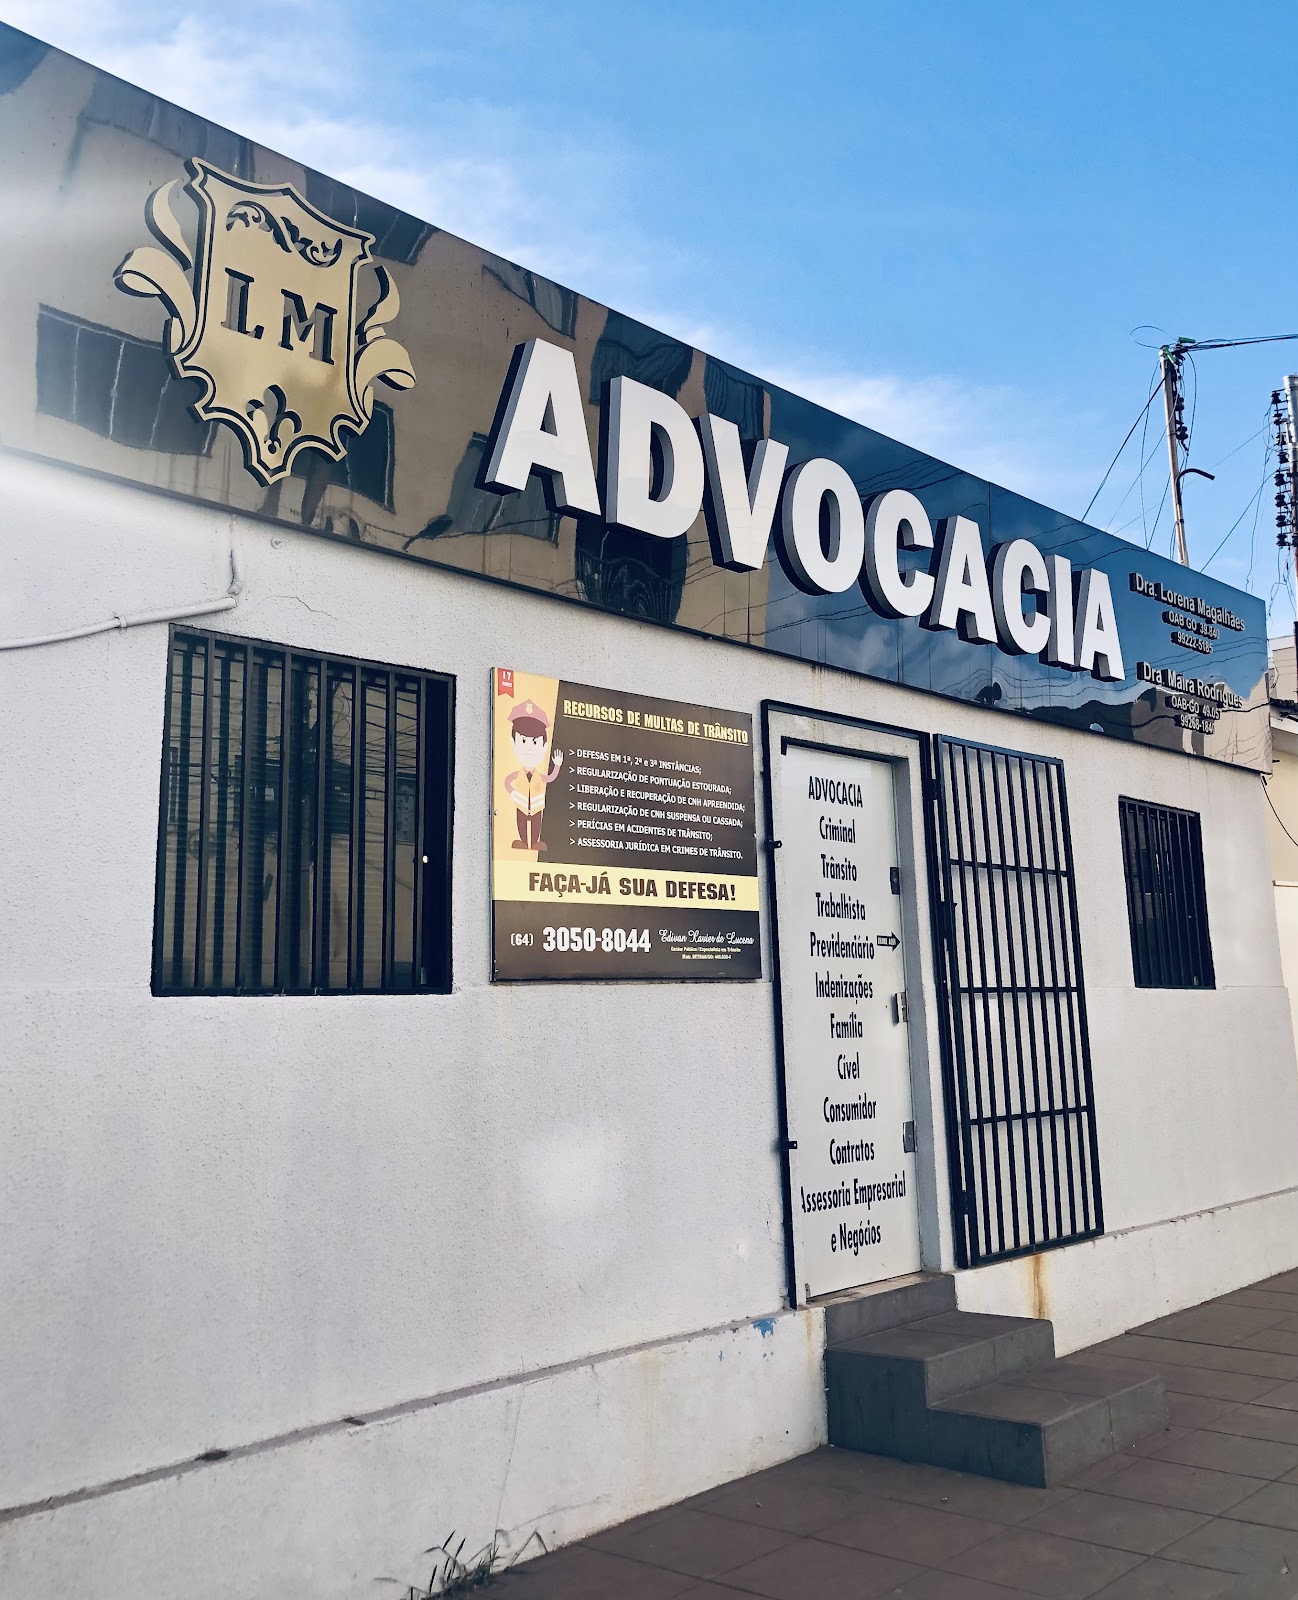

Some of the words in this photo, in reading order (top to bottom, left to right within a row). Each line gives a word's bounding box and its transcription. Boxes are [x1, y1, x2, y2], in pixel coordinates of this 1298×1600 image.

[474, 337, 1126, 682] ADVOCACIA
[1134, 572, 1157, 597] Dra.
[1160, 582, 1195, 612] Lorena
[1197, 597, 1246, 632] Magalhães
[1168, 610, 1185, 627] OAB
[1186, 617, 1197, 631] GO
[1143, 661, 1165, 685] Dra.
[1197, 679, 1243, 708] Rodrigues
[564, 699, 623, 723] RECURSOS
[627, 710, 640, 726] DE
[644, 713, 684, 734] MULTAS
[688, 722, 700, 736] DE
[703, 722, 748, 744] TRÂNSITO
[577, 749, 609, 761] DEFESAS
[611, 753, 621, 762] EM
[658, 760, 702, 775] INSTÂNCIAS;
[577, 766, 637, 783] REGULARIZAÇÃO
[639, 774, 648, 783] DE
[650, 775, 690, 790] PONTUAÇÃO
[692, 781, 732, 795] ESTOURADA;
[808, 775, 863, 808] ADVOCACIA
[577, 784, 619, 797] LIBERAÇÃO
[620, 788, 625, 797] E
[626, 789, 676, 804] RECUPERAÇÃO
[677, 796, 687, 805] DE
[688, 797, 702, 807] CNH
[703, 798, 746, 813] APREENDIDA;
[577, 802, 638, 817] REGULARIZAÇÃO
[640, 808, 649, 818] DE
[650, 809, 665, 820] CNH
[666, 811, 701, 823] SUSPENSA
[701, 815, 711, 824] OU
[712, 816, 743, 829] CASSADA;
[577, 818, 613, 831] PERÍCIAS
[614, 823, 625, 832] EM
[626, 825, 666, 837] ACIDENTES
[667, 828, 676, 837] DE
[677, 828, 713, 841] TRÂNSITO;
[819, 815, 856, 844] Criminal
[577, 838, 624, 849] ASSESSORIA
[625, 840, 659, 852] JURÍDICA
[661, 844, 671, 853] EM
[672, 845, 698, 856] CRIMES
[699, 847, 708, 857] DE
[709, 847, 743, 859] TRÂNSITO.
[820, 853, 858, 882] Trânsito
[528, 871, 611, 898] FAÇA-JÁ
[619, 877, 658, 897] SUA
[665, 880, 736, 902] DEFESA!
[815, 892, 866, 921] Trabalhista
[510, 933, 534, 947] (64)
[542, 926, 651, 953] 3050-8044
[658, 929, 688, 943] Edivan
[688, 929, 716, 943] Xavier
[716, 931, 725, 944] de
[726, 931, 755, 945] Lucena
[810, 931, 875, 960] Previdenciário
[815, 971, 873, 1005] Indenizações
[830, 1012, 863, 1039] Família
[837, 1052, 860, 1080] Cível
[823, 1092, 877, 1123] Consumidor
[829, 1138, 875, 1165] Contratos
[853, 1170, 906, 1211] Empresarial
[831, 1233, 837, 1253] e
[839, 1219, 881, 1257] Negócios
